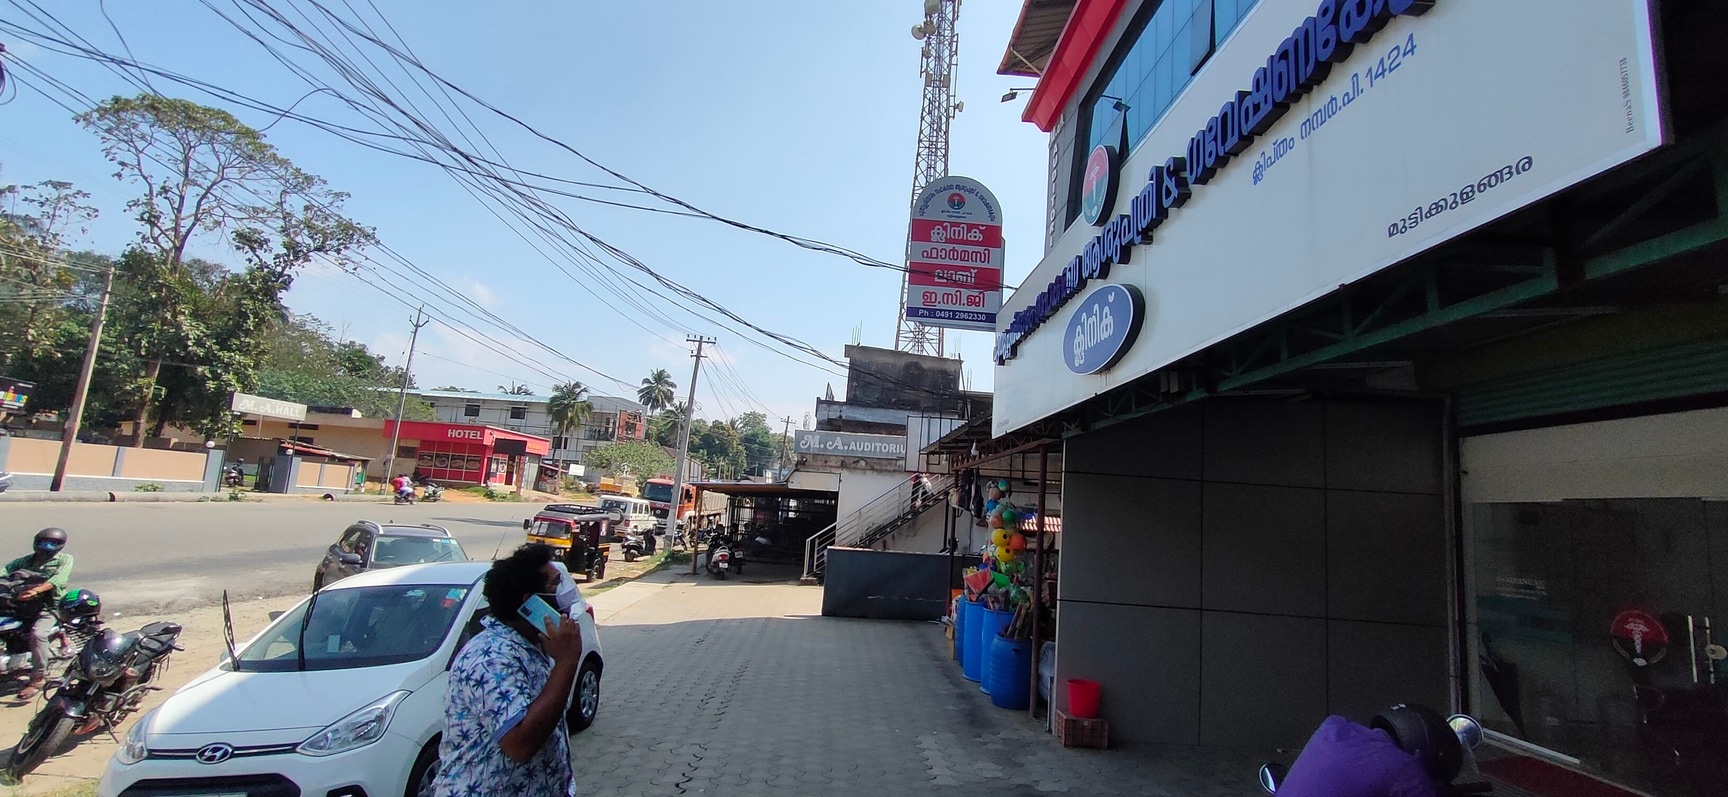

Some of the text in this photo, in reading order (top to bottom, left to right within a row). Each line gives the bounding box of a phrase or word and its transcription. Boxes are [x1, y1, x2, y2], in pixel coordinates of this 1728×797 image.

[1048, 143, 1060, 248] AUDITORI
[1387, 155, 1534, 238] മുട്ടിക്കുളങ്ങര
[1081, 166, 1162, 280] ആശുപത്രി
[1162, 157, 1183, 209] &
[930, 222, 987, 243] ക്ലിനിക്
[921, 245, 991, 265] ഫാർമസി
[922, 289, 986, 308] ഇ.സി.ജി
[935, 310, 953, 319] 0491
[955, 311, 987, 321] 2962330
[1073, 290, 1115, 367] ക്ലിനിക്
[275, 405, 301, 417] HALL
[447, 428, 483, 440] HOTEL
[849, 441, 906, 453] AUDITORIU
